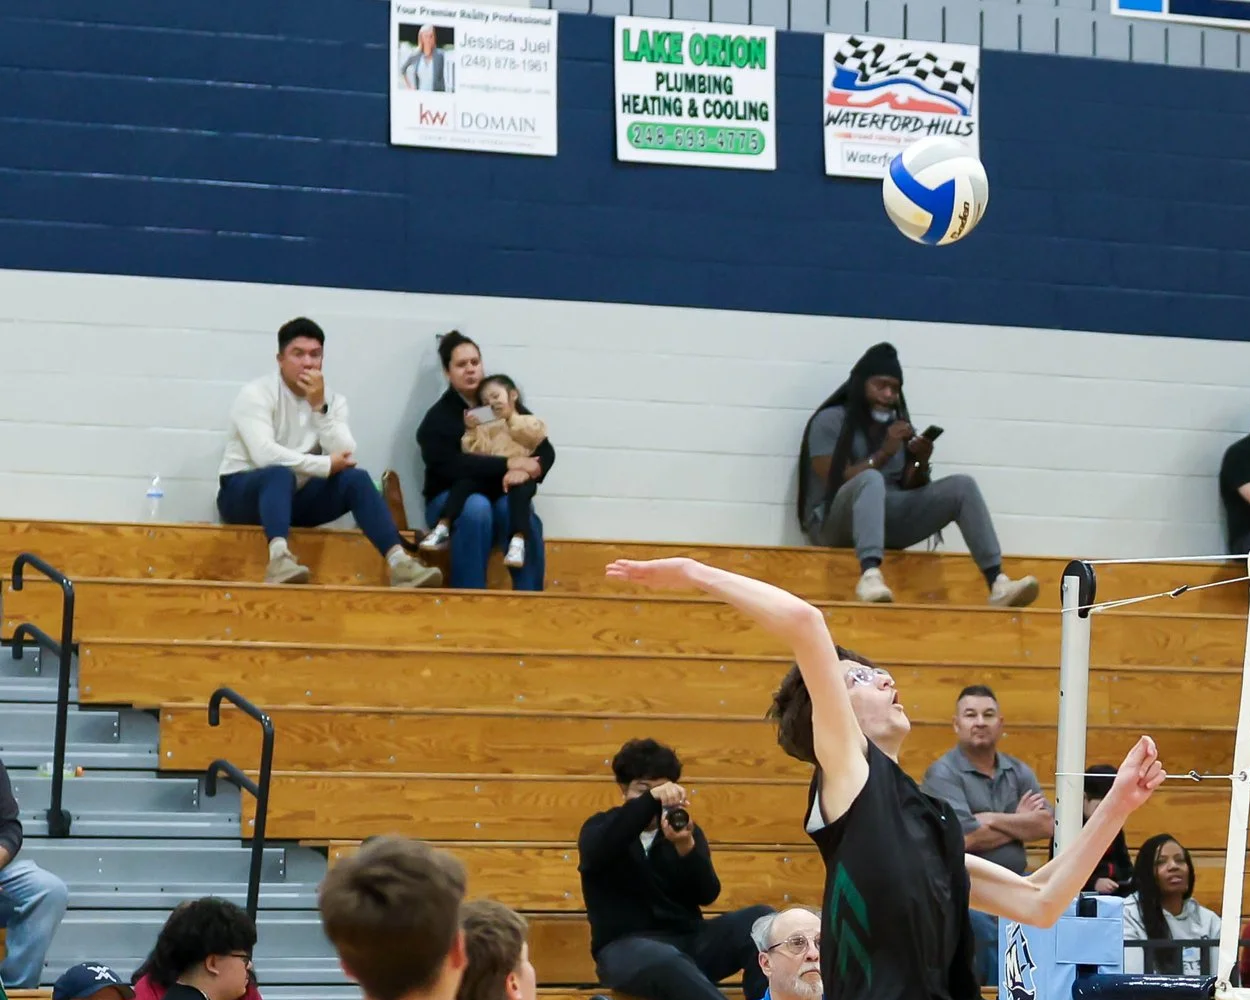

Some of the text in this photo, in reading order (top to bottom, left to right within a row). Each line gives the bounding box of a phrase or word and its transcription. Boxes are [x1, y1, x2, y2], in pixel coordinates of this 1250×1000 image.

[420, 7, 457, 18] Premier
[492, 12, 552, 26] Professional
[460, 32, 551, 54] Jessica Juel
[622, 28, 767, 70] LAKE ORION
[460, 54, 491, 71] (248)
[655, 71, 734, 95] PLUMBING
[419, 103, 448, 126] kw
[621, 94, 769, 122] HEATING & COOLING
[460, 111, 537, 133] DOMAIN
[824, 109, 975, 137] WATERFORD HILLS
[632, 126, 760, 153] 248-693-4775
